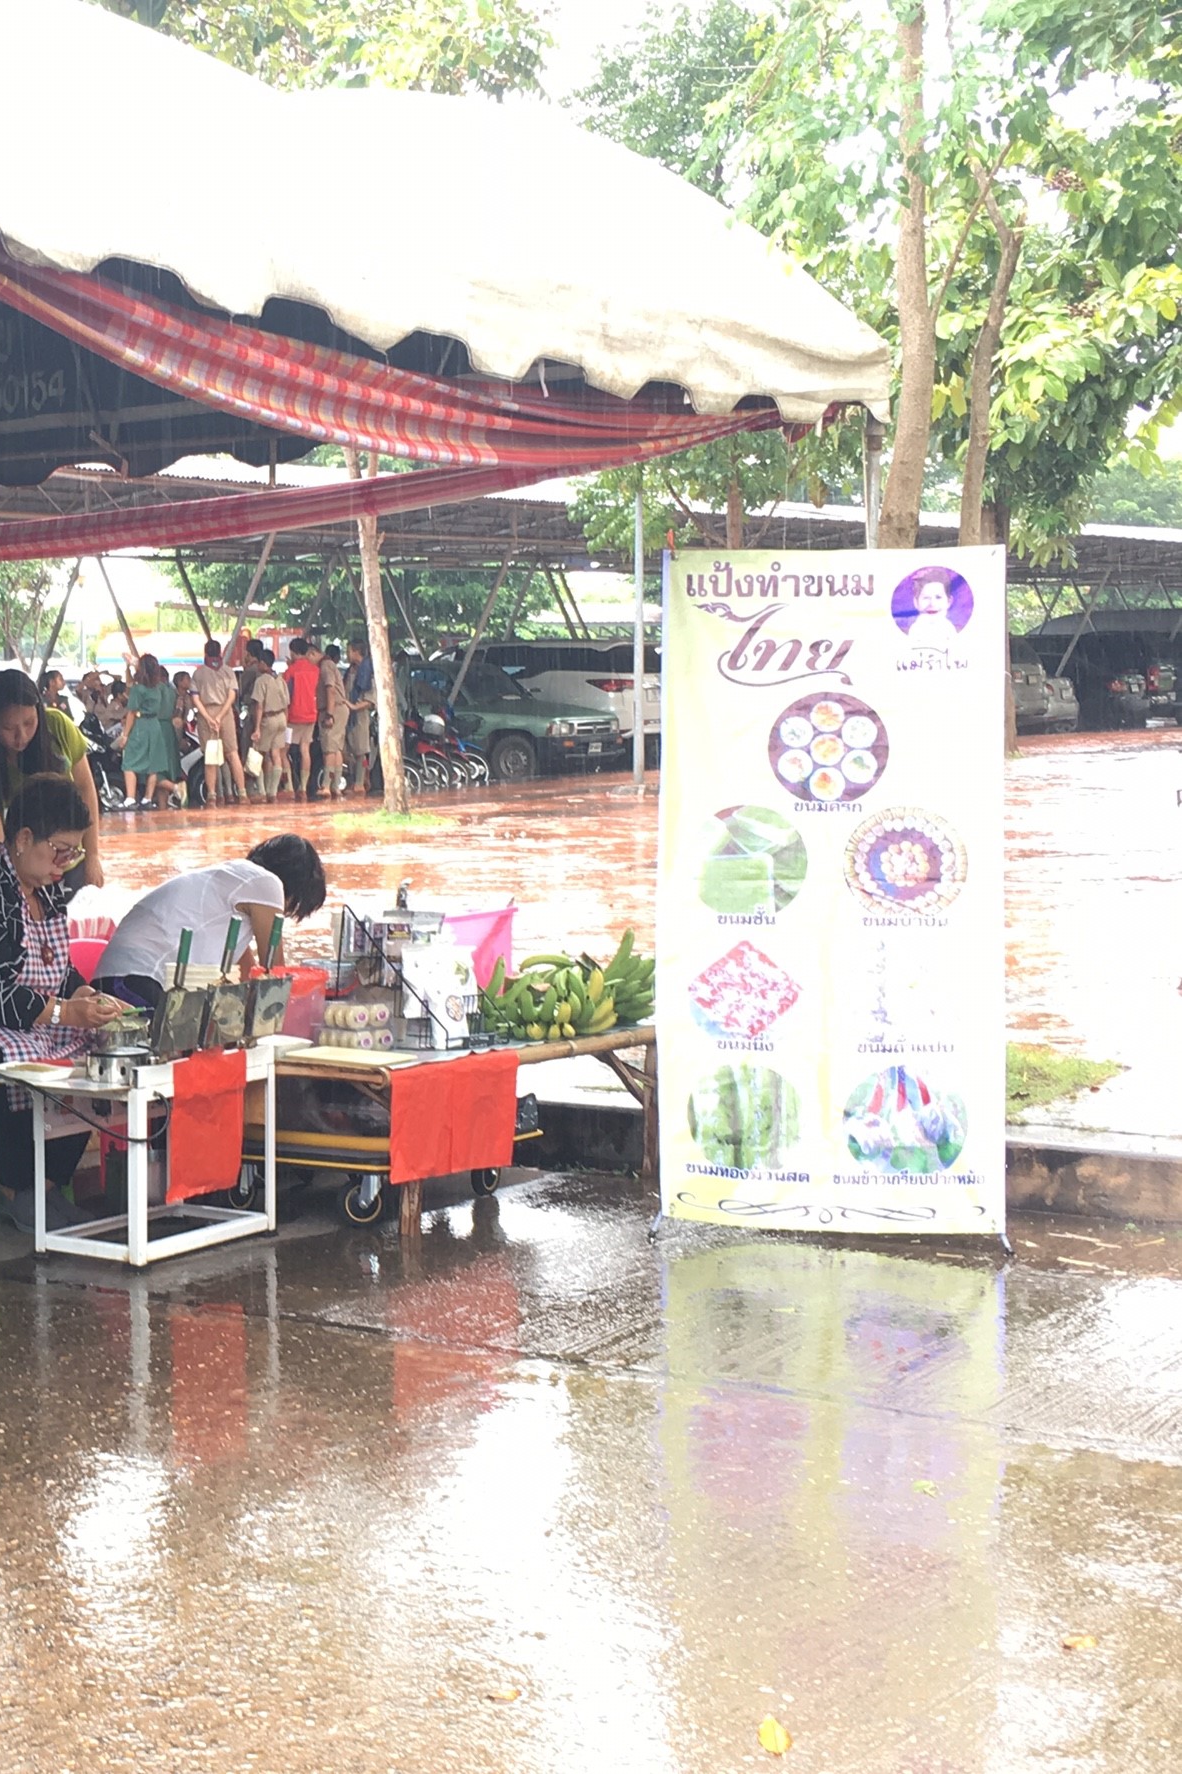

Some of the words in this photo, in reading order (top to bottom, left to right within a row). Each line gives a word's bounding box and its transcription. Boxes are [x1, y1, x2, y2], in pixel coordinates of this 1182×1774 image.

[685, 561, 875, 598] แป้งทำขนม
[693, 602, 854, 687] ไทย
